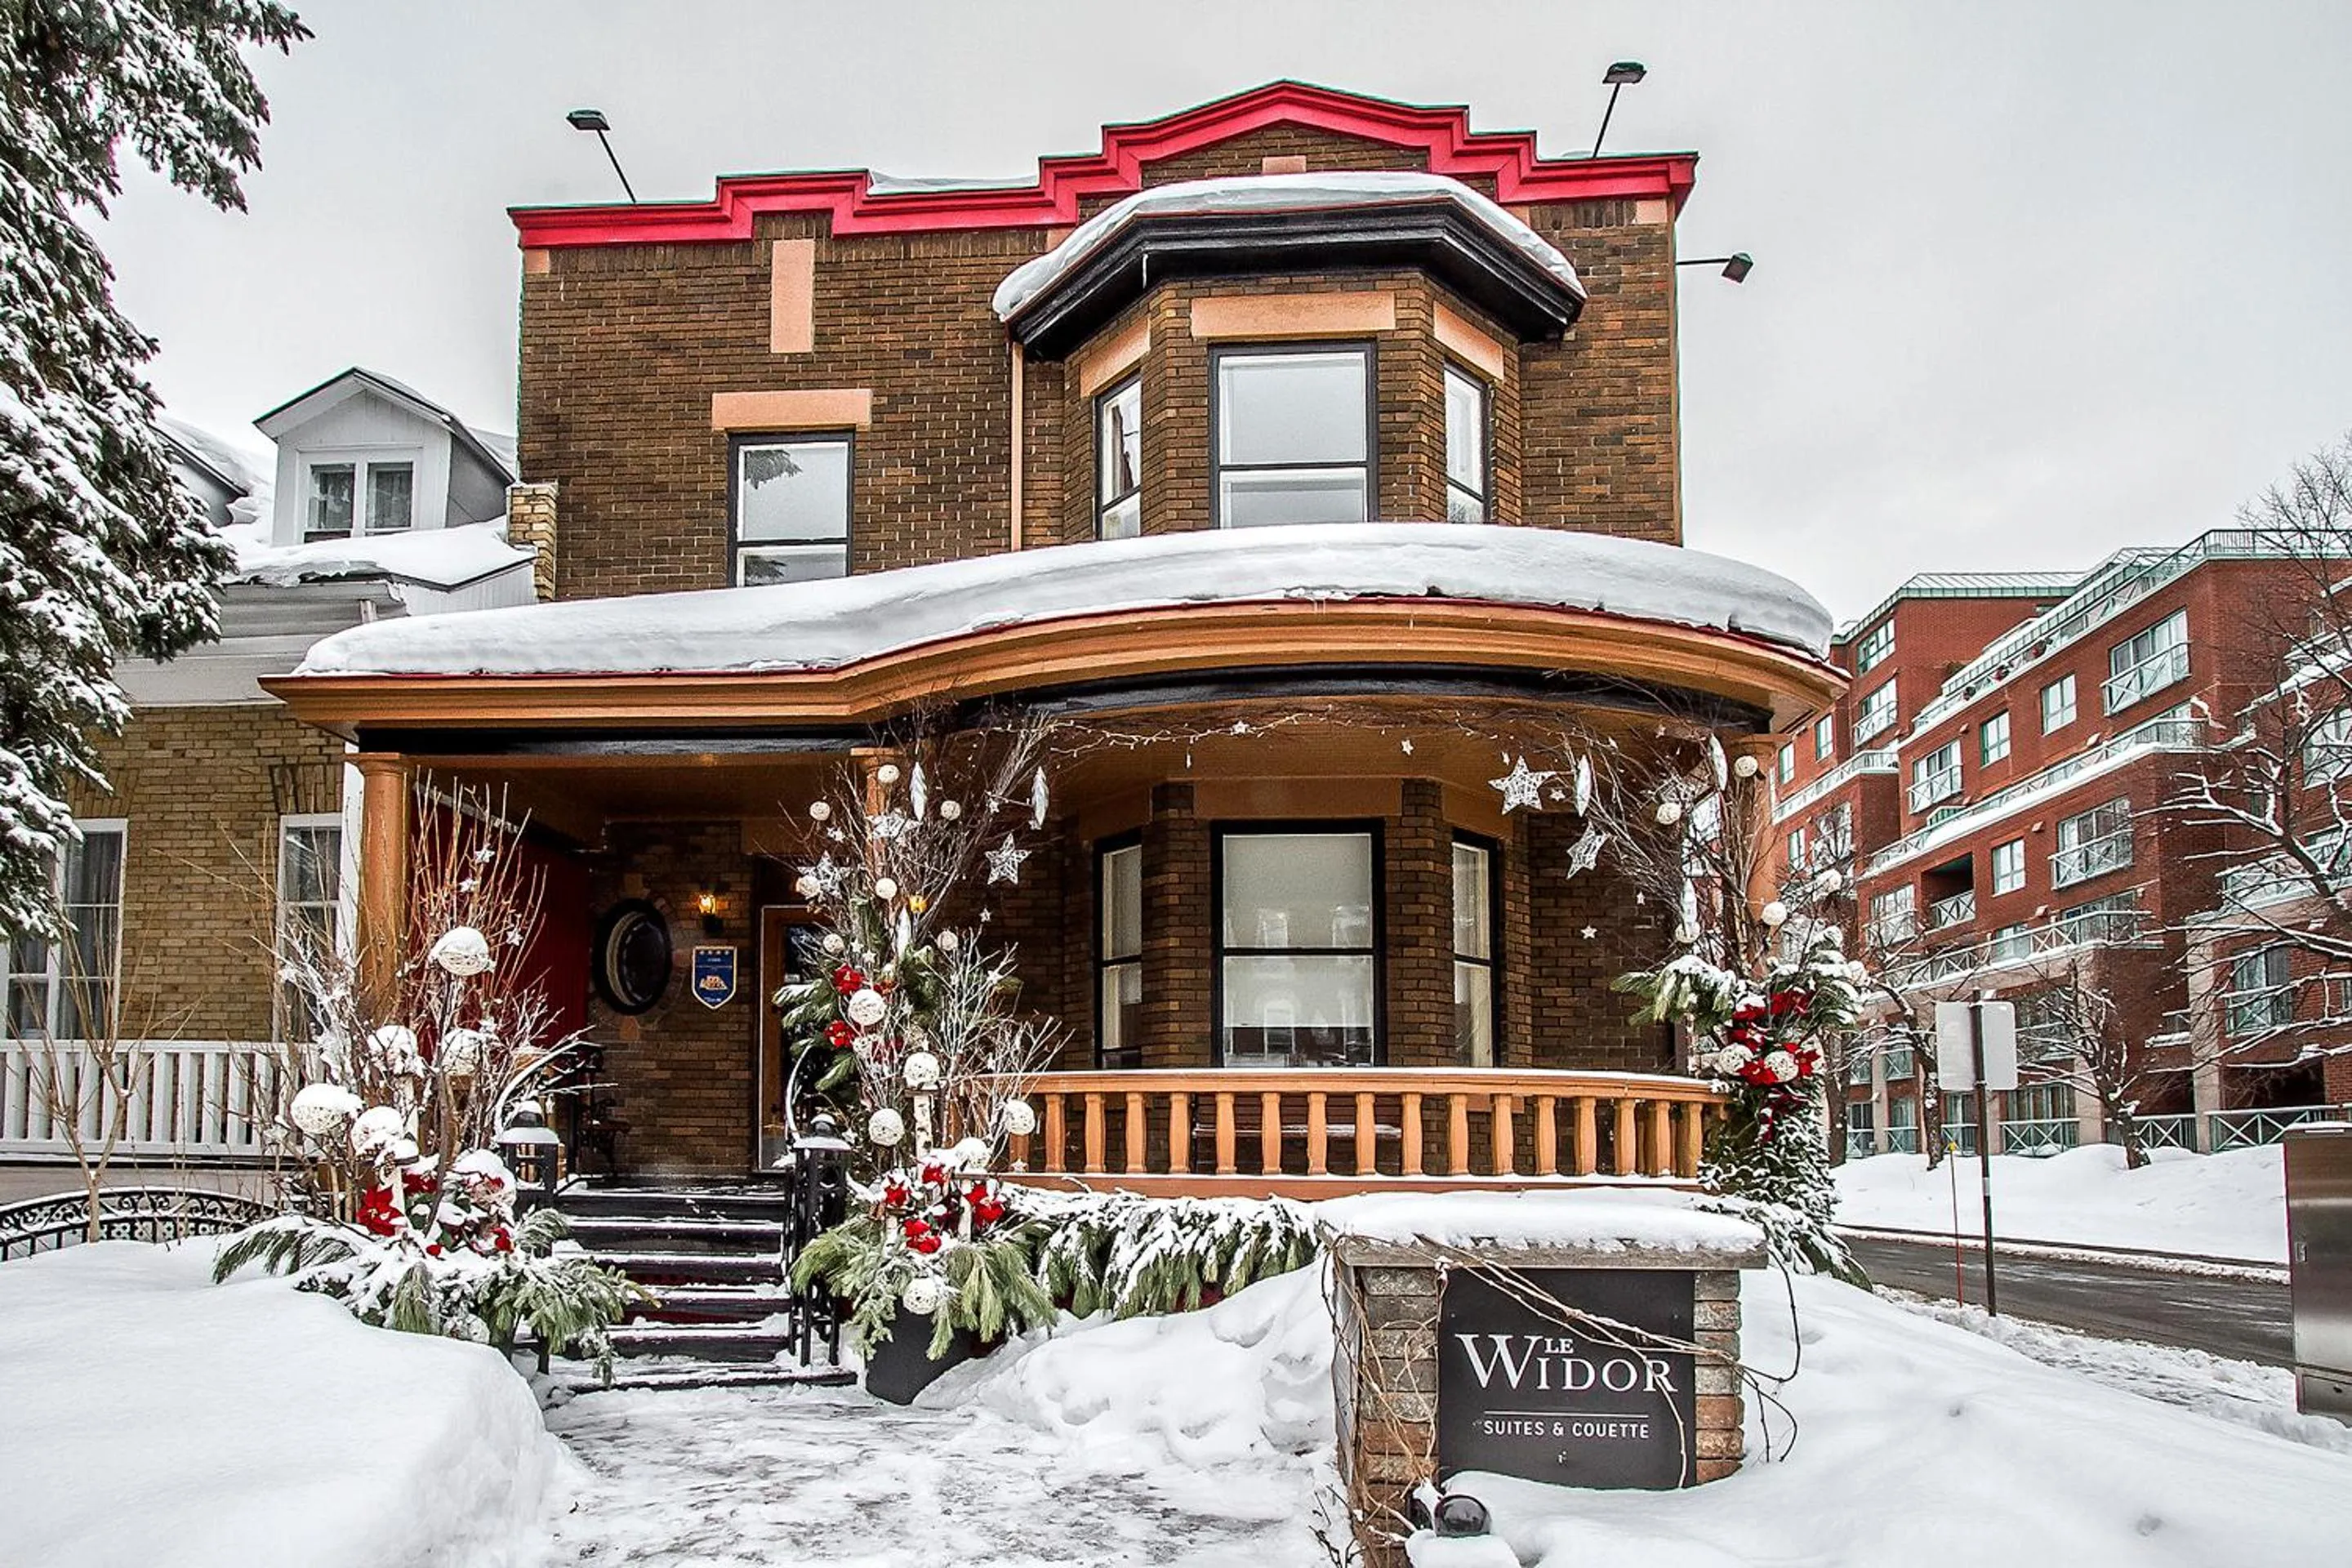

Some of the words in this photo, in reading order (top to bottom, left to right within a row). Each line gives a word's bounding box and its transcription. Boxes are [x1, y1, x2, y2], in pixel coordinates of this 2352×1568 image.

[1544, 1338, 1574, 1354] LE
[1454, 1333, 1678, 1392] WIDOR
[1483, 1419, 1545, 1437] SUITES
[1552, 1421, 1564, 1437] &
[1572, 1422, 1650, 1439] COUETTE
